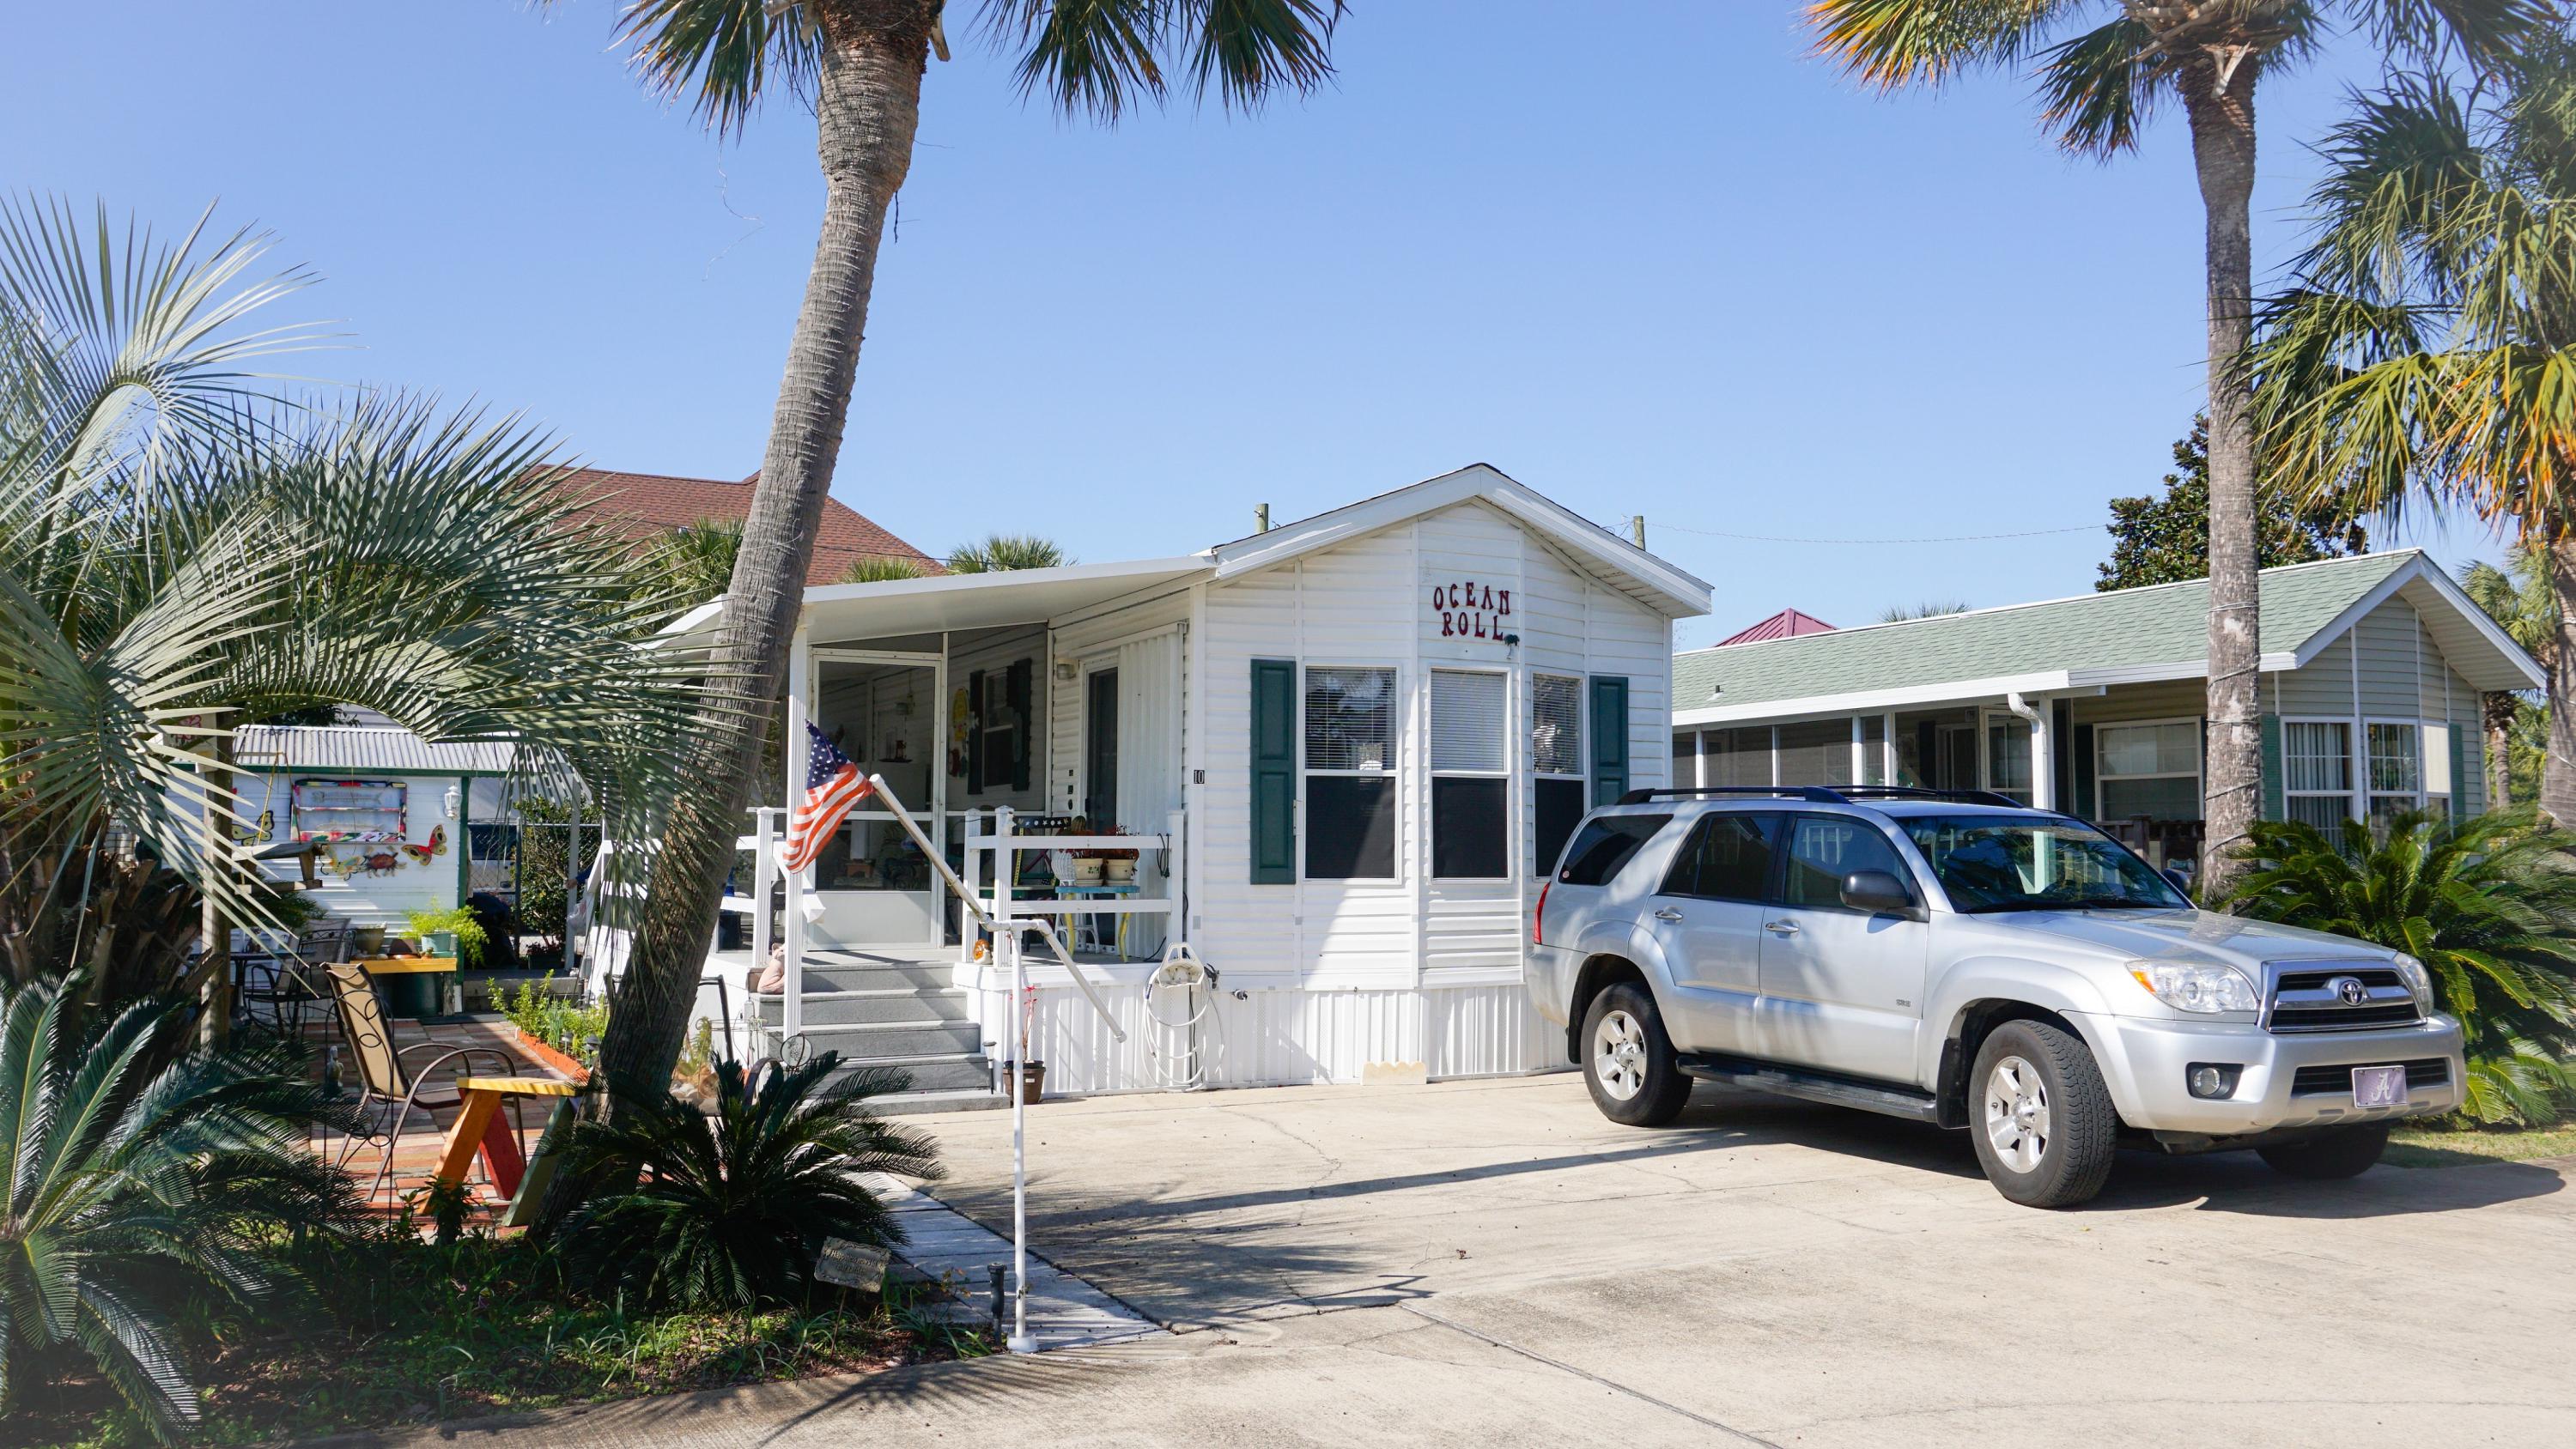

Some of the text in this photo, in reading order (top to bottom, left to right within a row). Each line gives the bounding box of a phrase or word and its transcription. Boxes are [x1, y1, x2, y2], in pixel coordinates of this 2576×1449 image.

[1433, 582, 1510, 615] OCEAN
[1442, 611, 1504, 641] ROLL
[1194, 770, 1204, 784] 10
